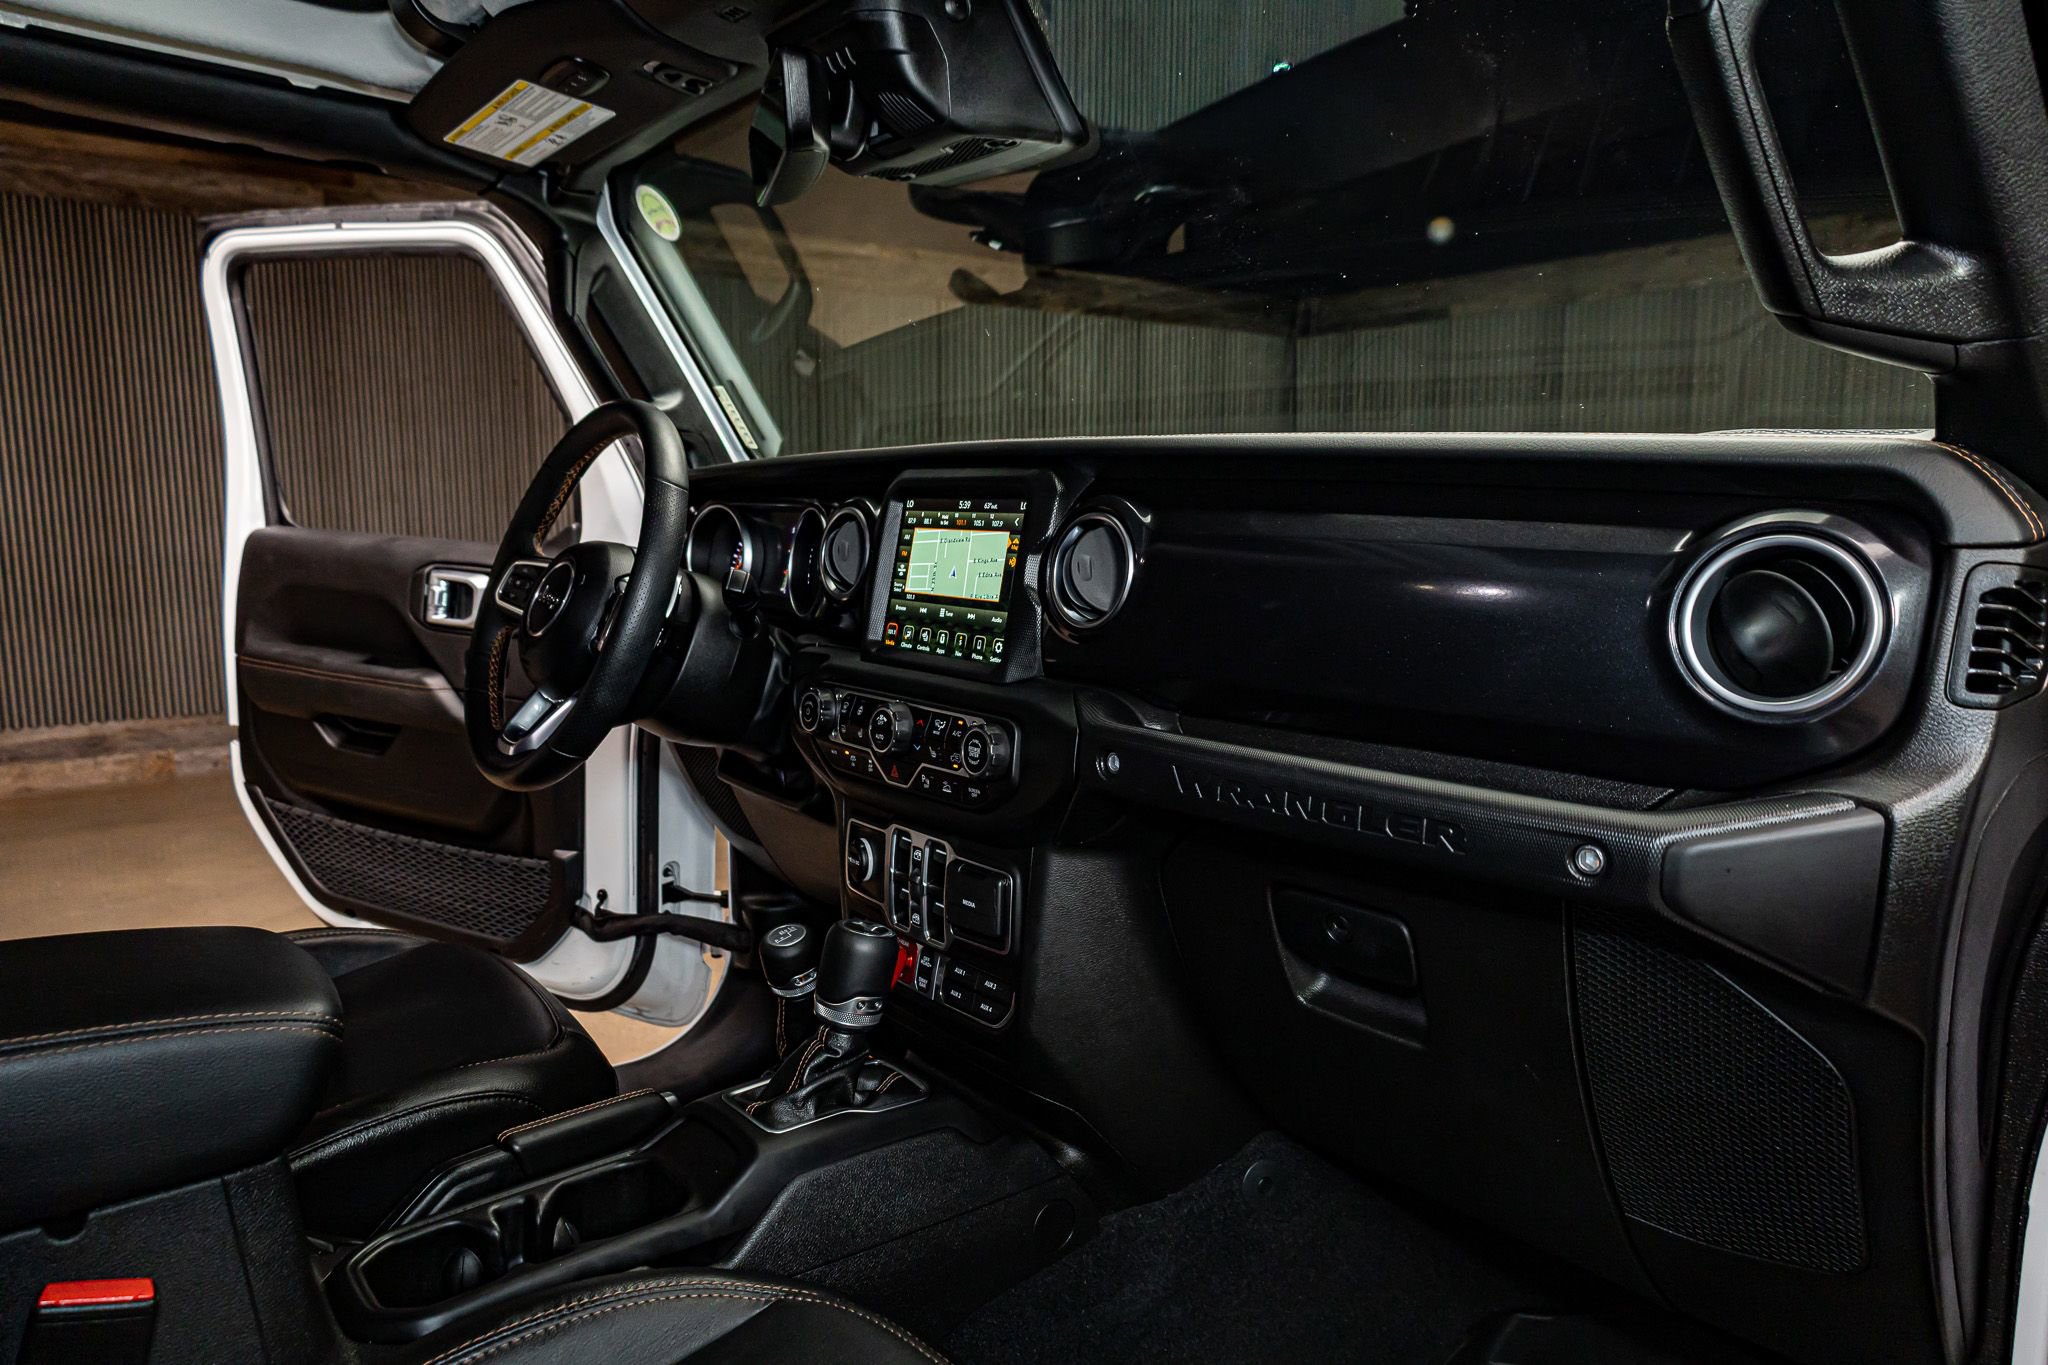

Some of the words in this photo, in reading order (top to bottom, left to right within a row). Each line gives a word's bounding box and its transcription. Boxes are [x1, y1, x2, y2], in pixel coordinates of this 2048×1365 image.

[959, 501, 971, 509] 5:39
[991, 616, 1003, 624] Audio
[900, 641, 913, 649] Climate
[916, 644, 930, 652] Controls
[971, 653, 983, 661] Phone
[1172, 764, 1468, 856] WRANGLER
[962, 898, 976, 909] MEDIA
